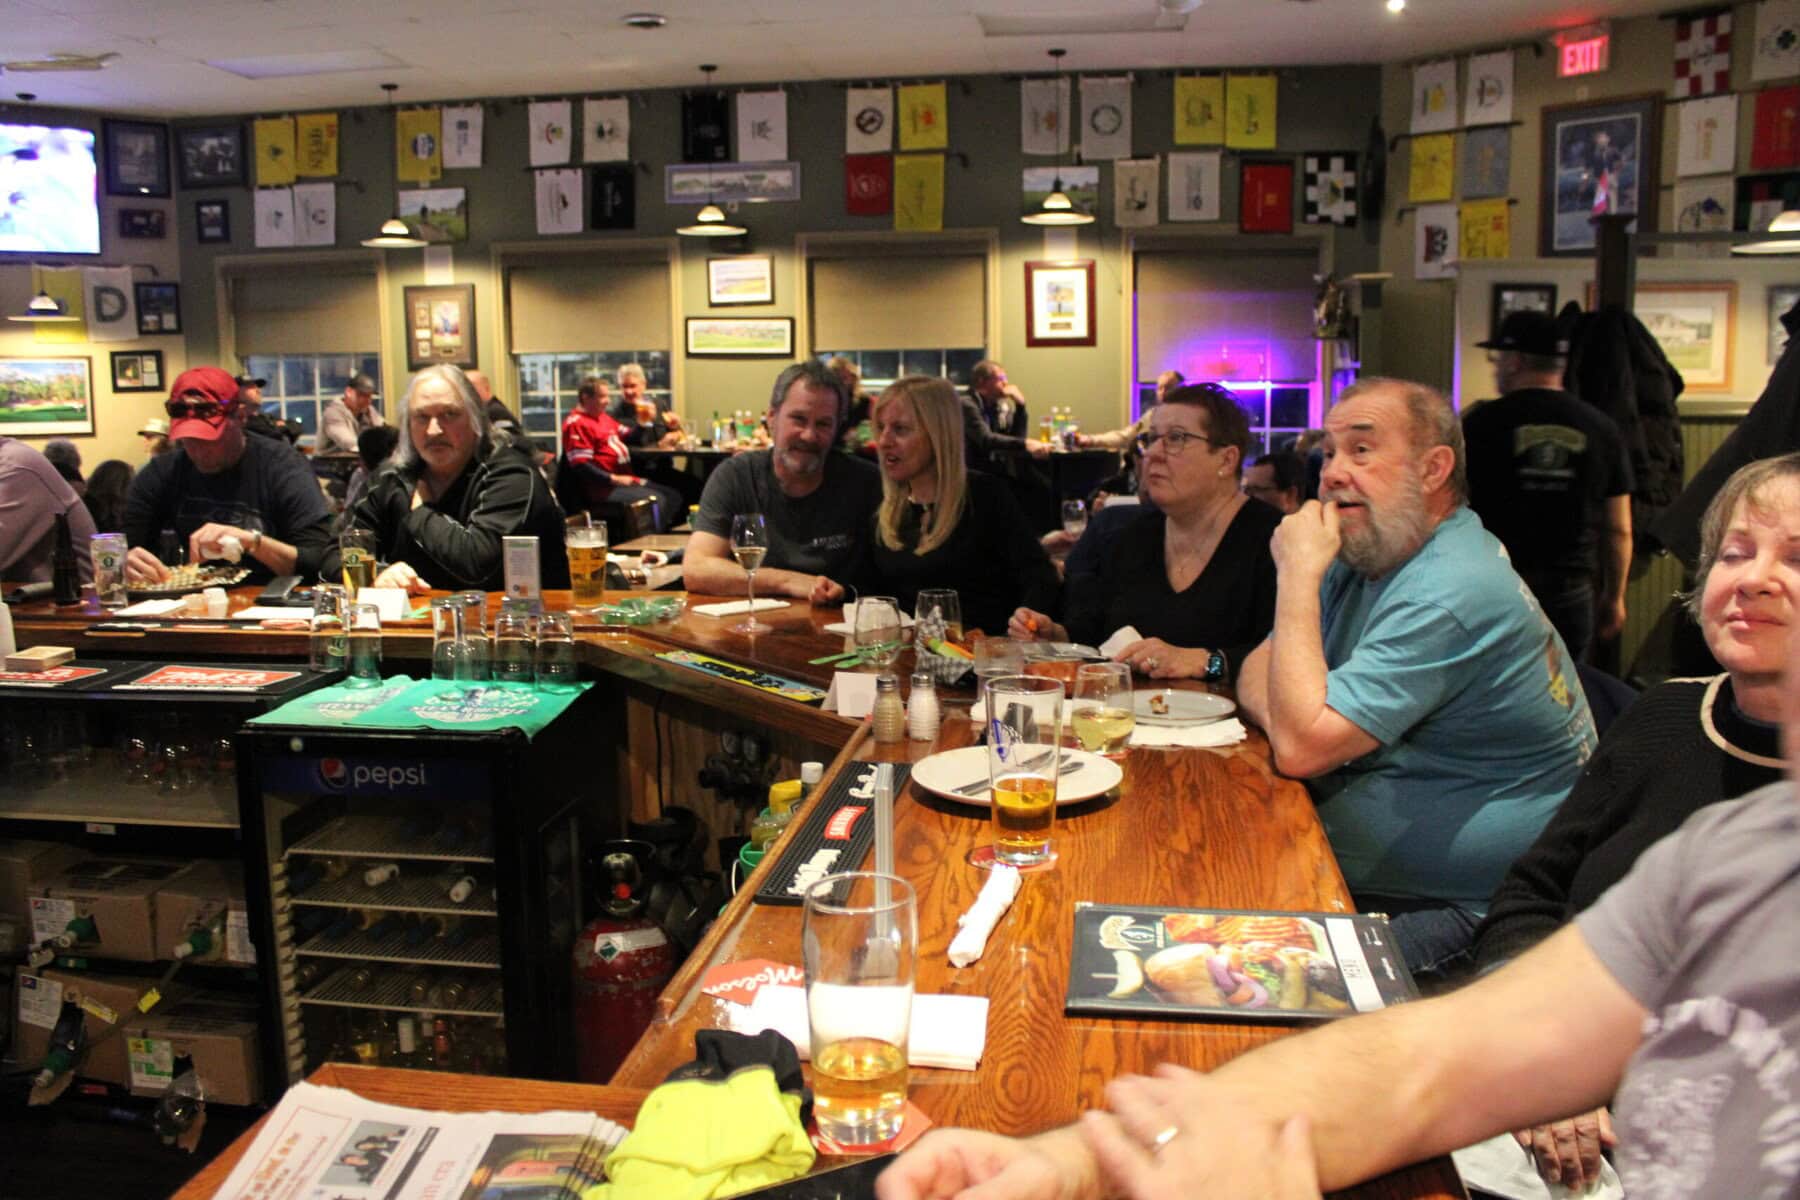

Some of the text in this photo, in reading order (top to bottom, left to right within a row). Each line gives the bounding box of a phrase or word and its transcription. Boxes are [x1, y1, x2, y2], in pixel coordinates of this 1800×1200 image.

[1563, 39, 1601, 76] EXIT
[354, 763, 425, 790] pepsi
[702, 965, 804, 996] Molson
